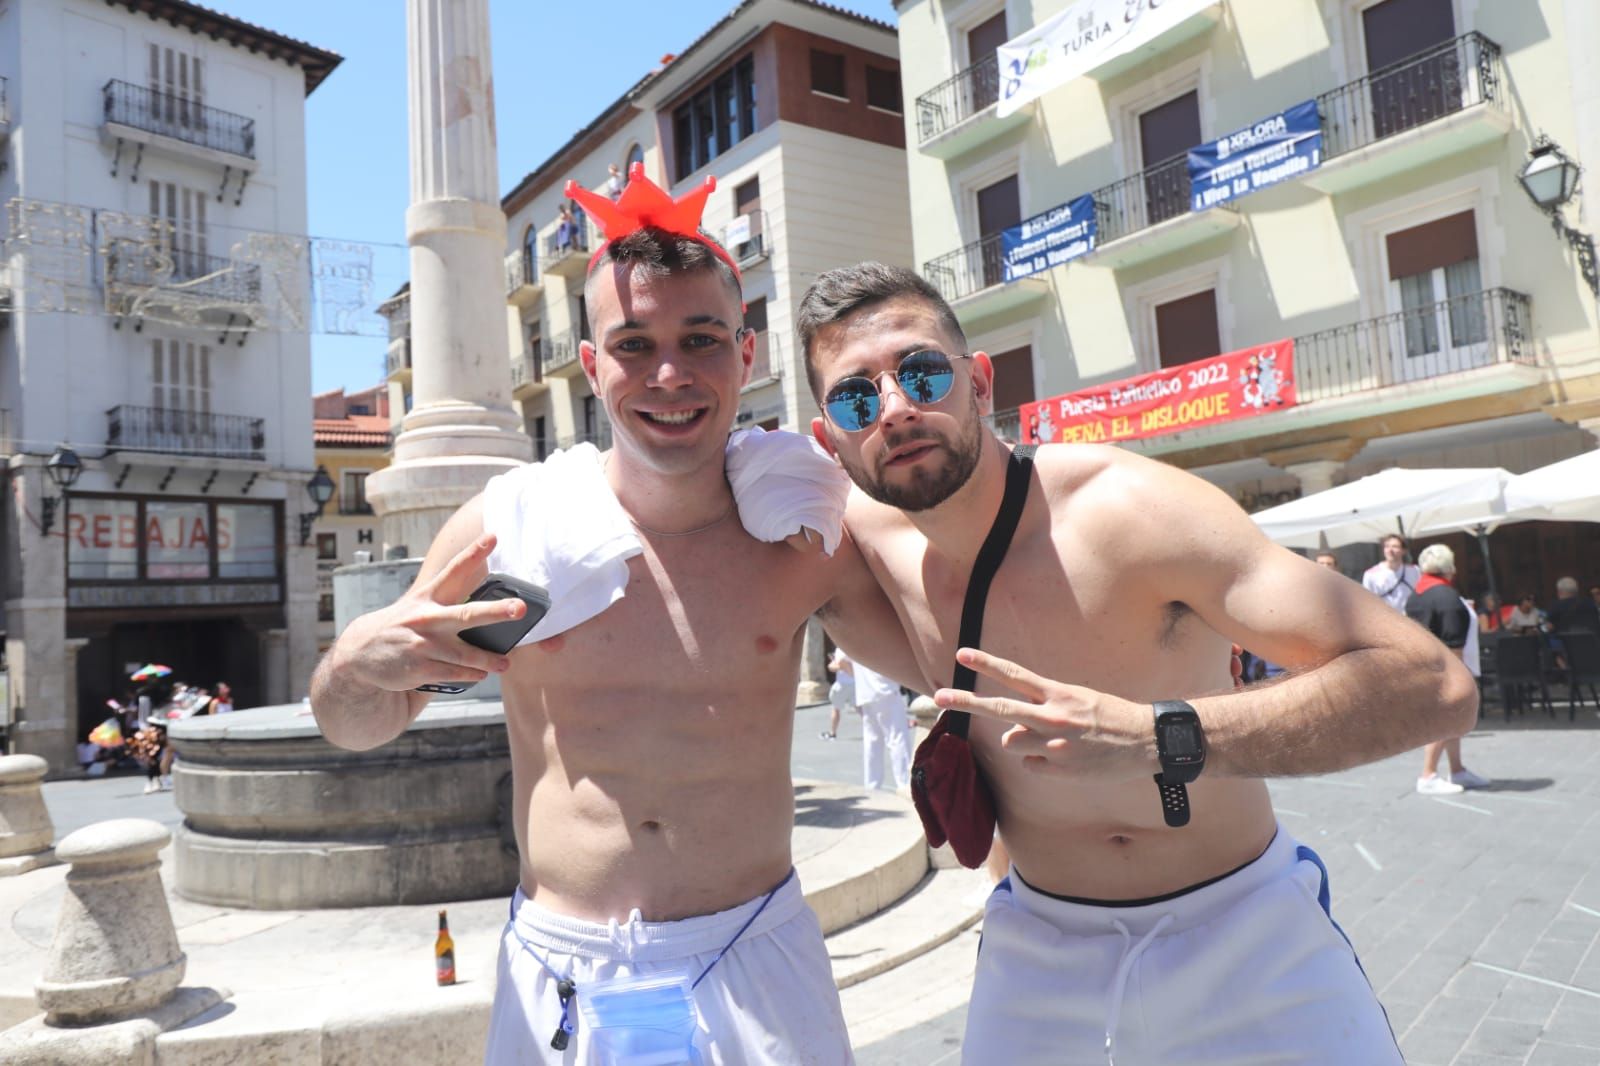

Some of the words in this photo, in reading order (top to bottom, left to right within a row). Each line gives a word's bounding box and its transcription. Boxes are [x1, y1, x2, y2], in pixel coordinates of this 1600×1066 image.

[1062, 22, 1112, 56] TURIA
[1230, 116, 1287, 149] XPLORA
[1187, 363, 1230, 389] 2022
[1111, 416, 1135, 437] EL
[1141, 392, 1231, 432] DISLOQUE
[67, 513, 231, 550] REBAJAS
